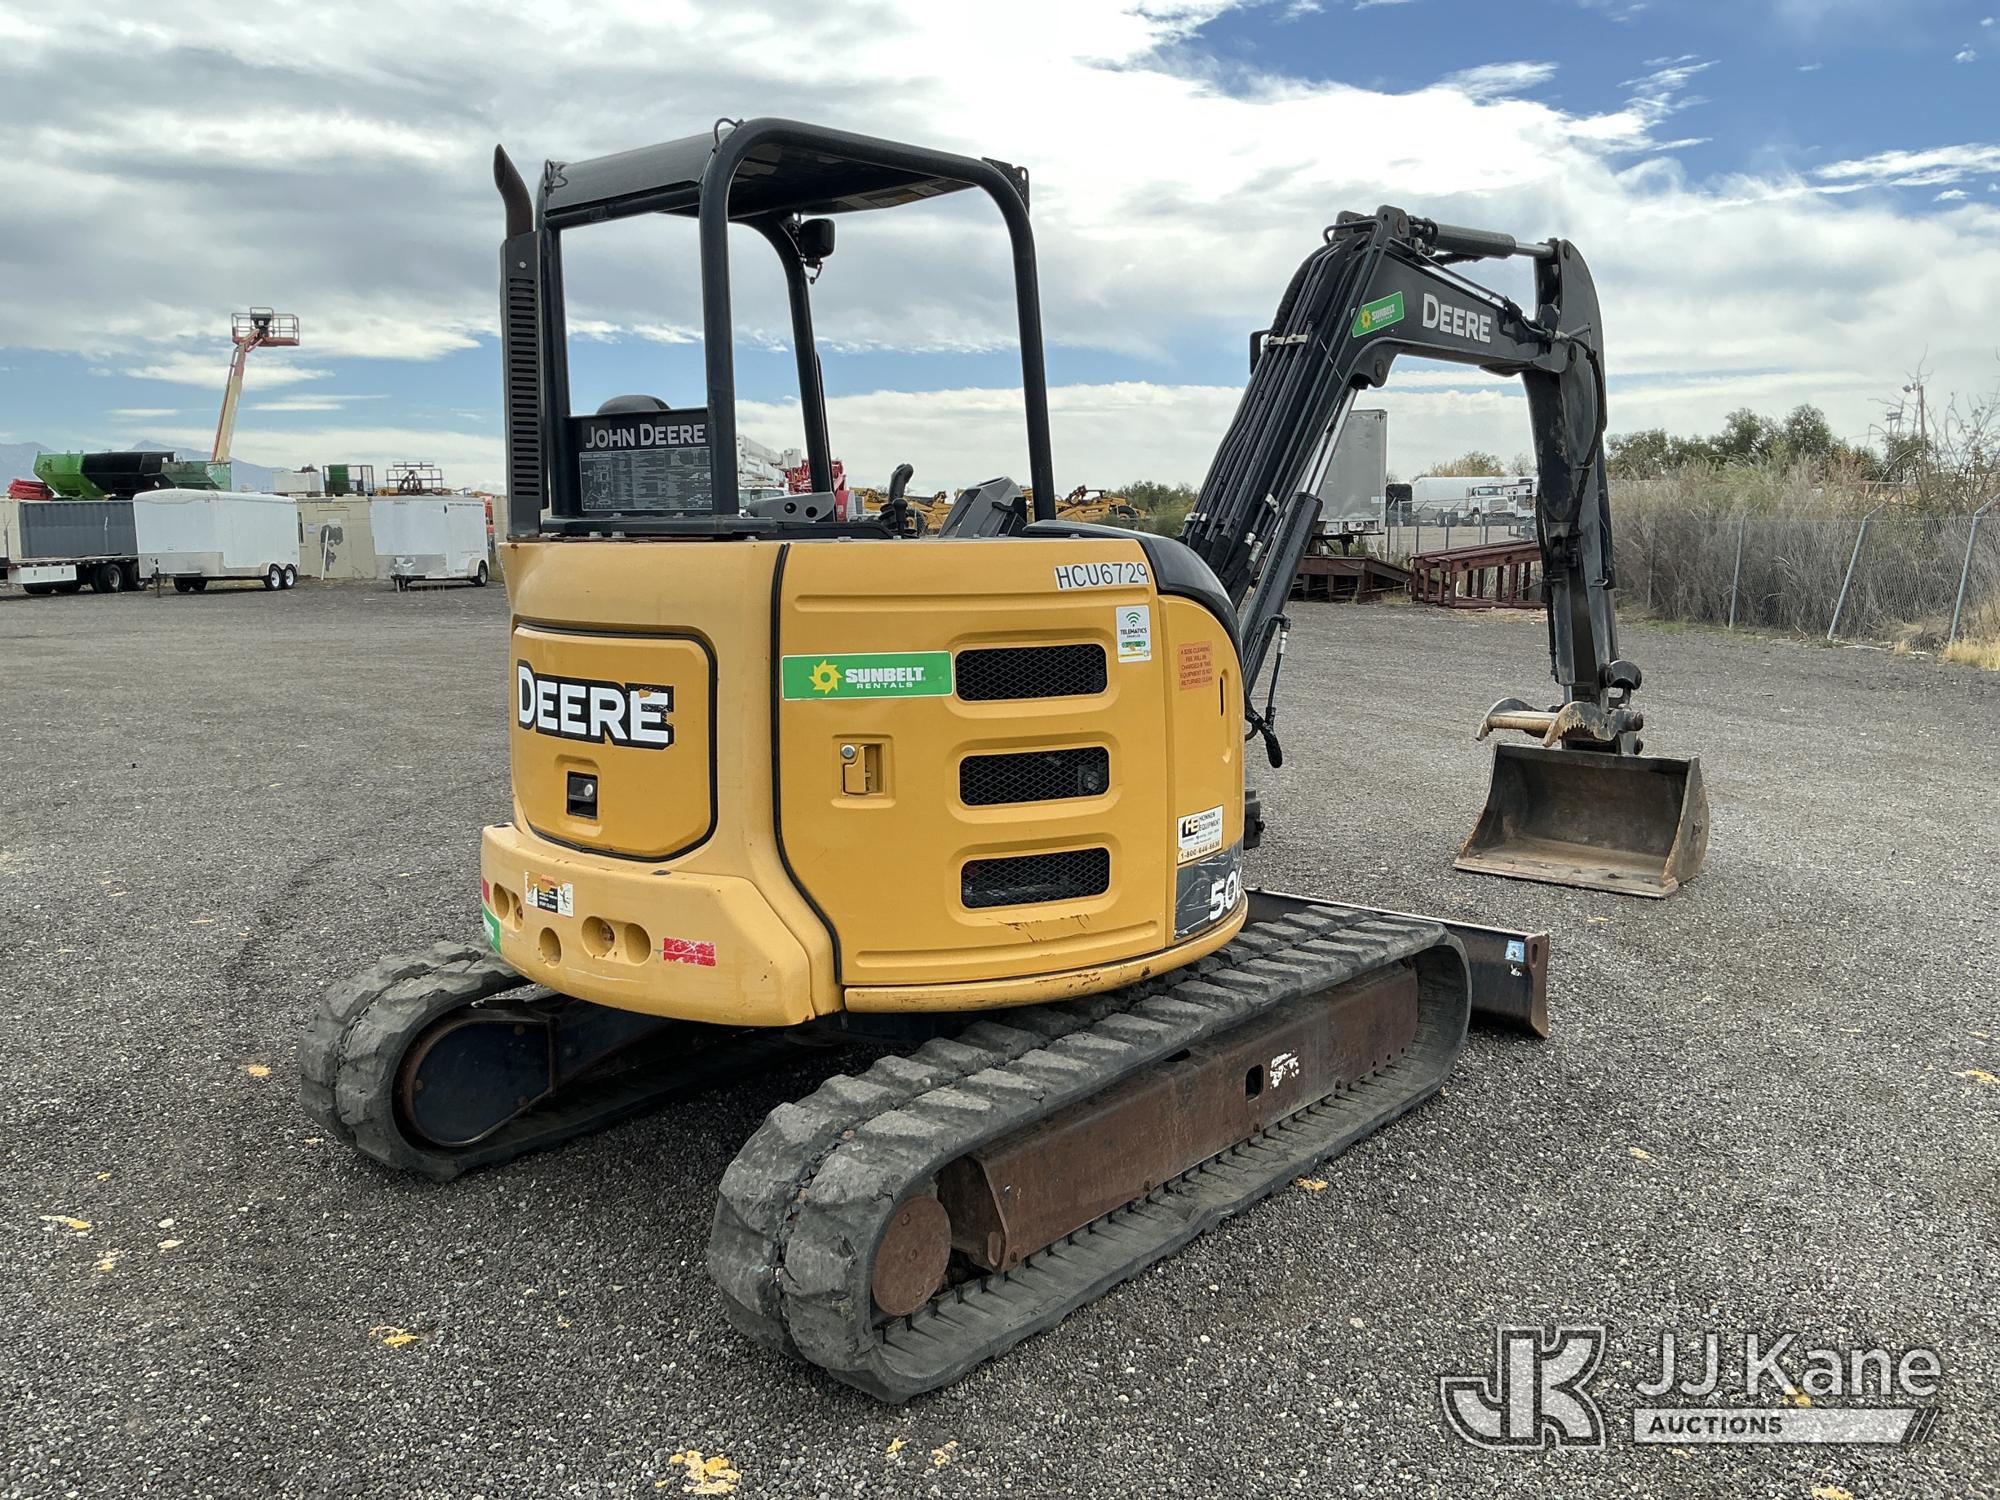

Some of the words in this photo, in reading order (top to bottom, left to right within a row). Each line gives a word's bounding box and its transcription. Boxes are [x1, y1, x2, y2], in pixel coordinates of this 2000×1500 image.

[1422, 292, 1492, 344] DEERE
[586, 426, 635, 448] JOHN
[640, 423, 706, 446] DEERE
[1056, 562, 1150, 589] HCU6729
[1120, 628, 1147, 636] TELEMATICS
[845, 667, 924, 683] SUNBELT
[517, 663, 670, 744] DEERE
